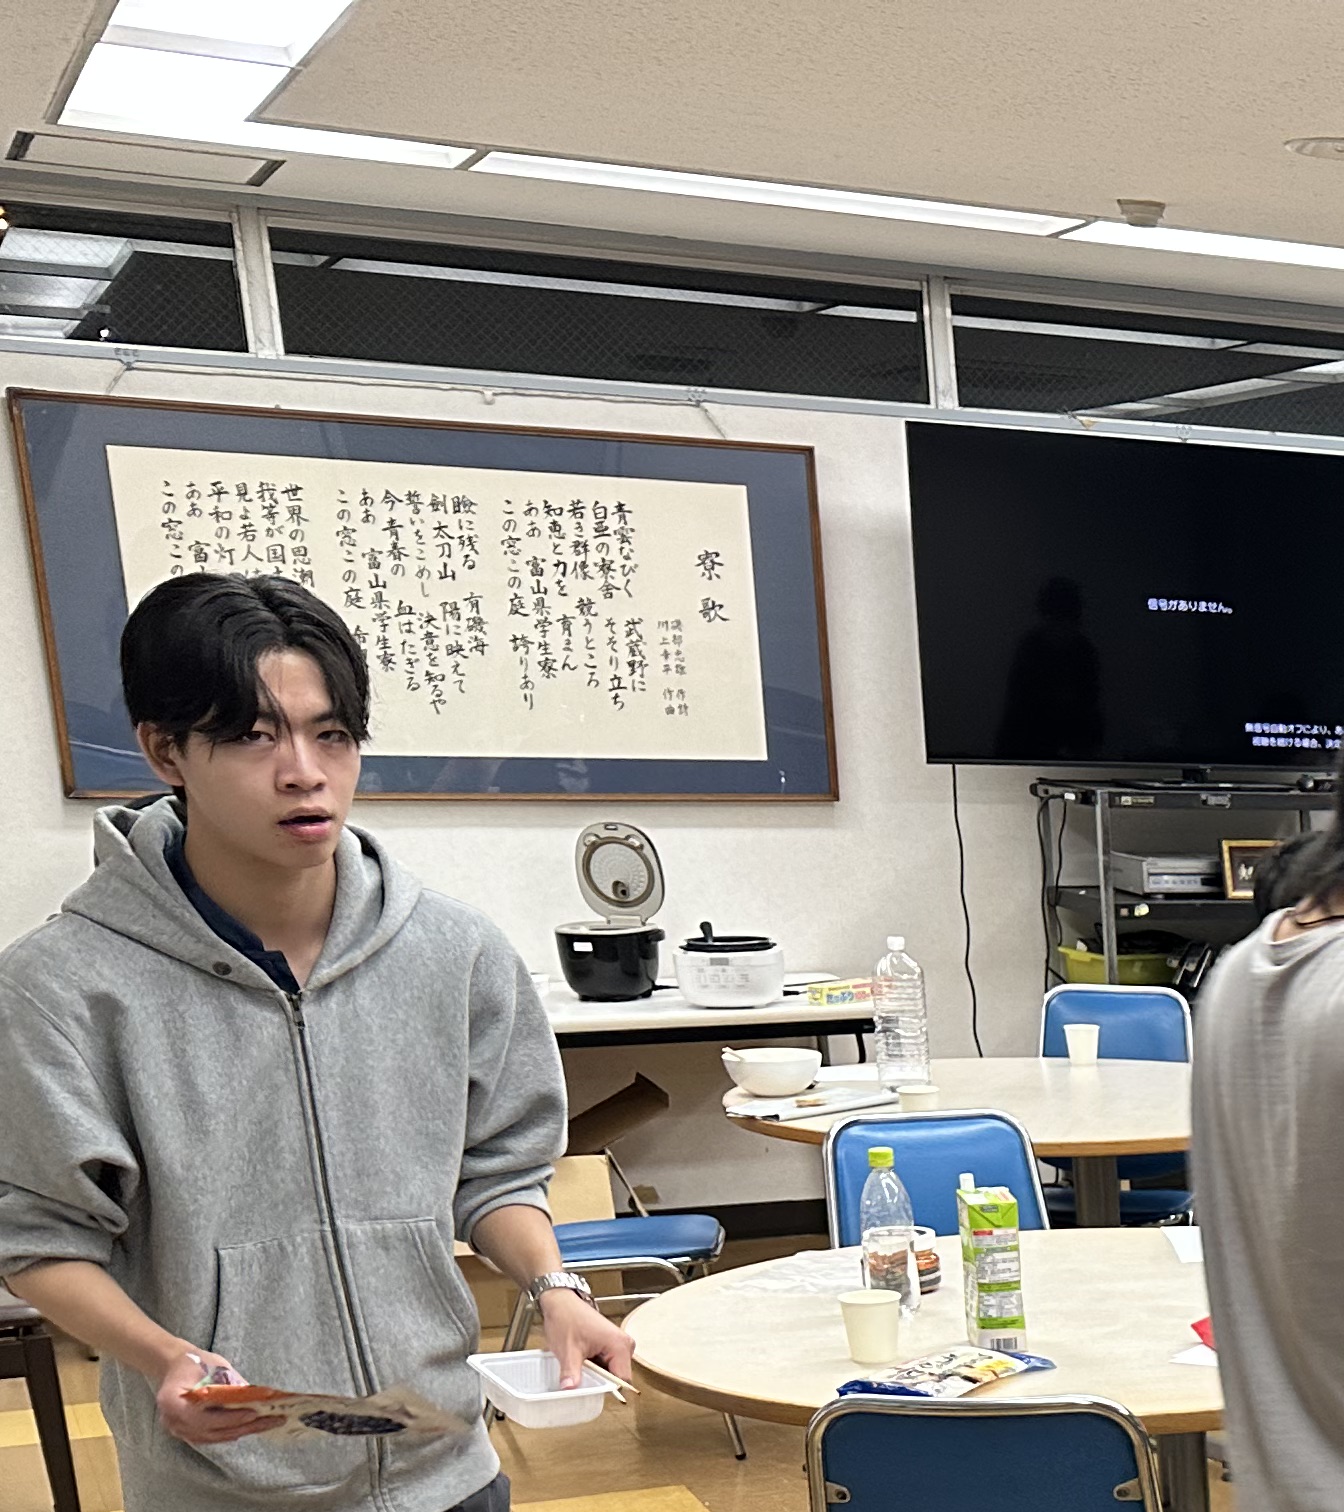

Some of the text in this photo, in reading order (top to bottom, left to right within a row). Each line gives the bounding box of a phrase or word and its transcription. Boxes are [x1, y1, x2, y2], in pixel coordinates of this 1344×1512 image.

[185, 481, 203, 518] ああ
[359, 488, 376, 525] ああ
[523, 499, 541, 538] ああ
